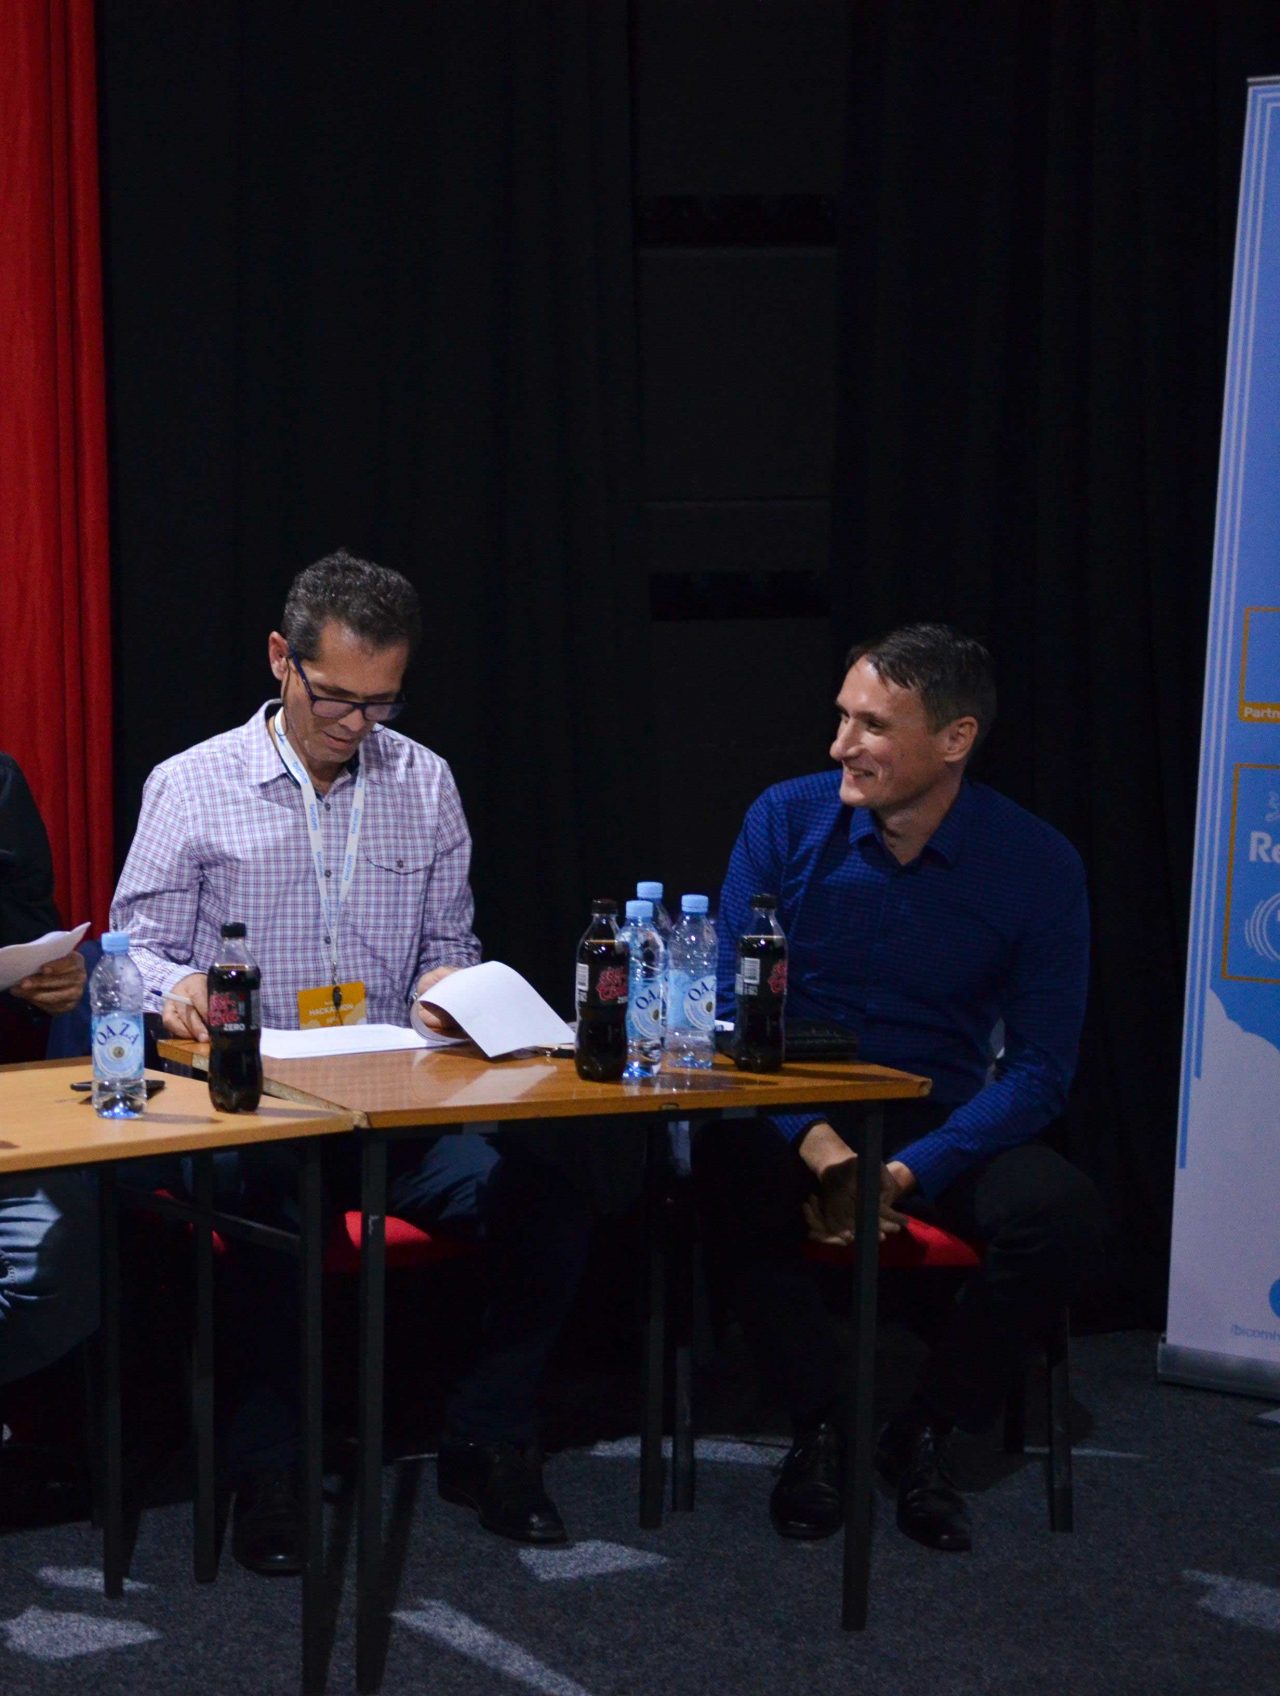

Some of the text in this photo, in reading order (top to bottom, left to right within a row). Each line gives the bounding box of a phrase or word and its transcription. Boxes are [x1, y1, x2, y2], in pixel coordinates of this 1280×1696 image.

[1243, 706, 1280, 719] Partn
[96, 1022, 139, 1046] OAZA
[223, 1023, 246, 1032] ZERO
